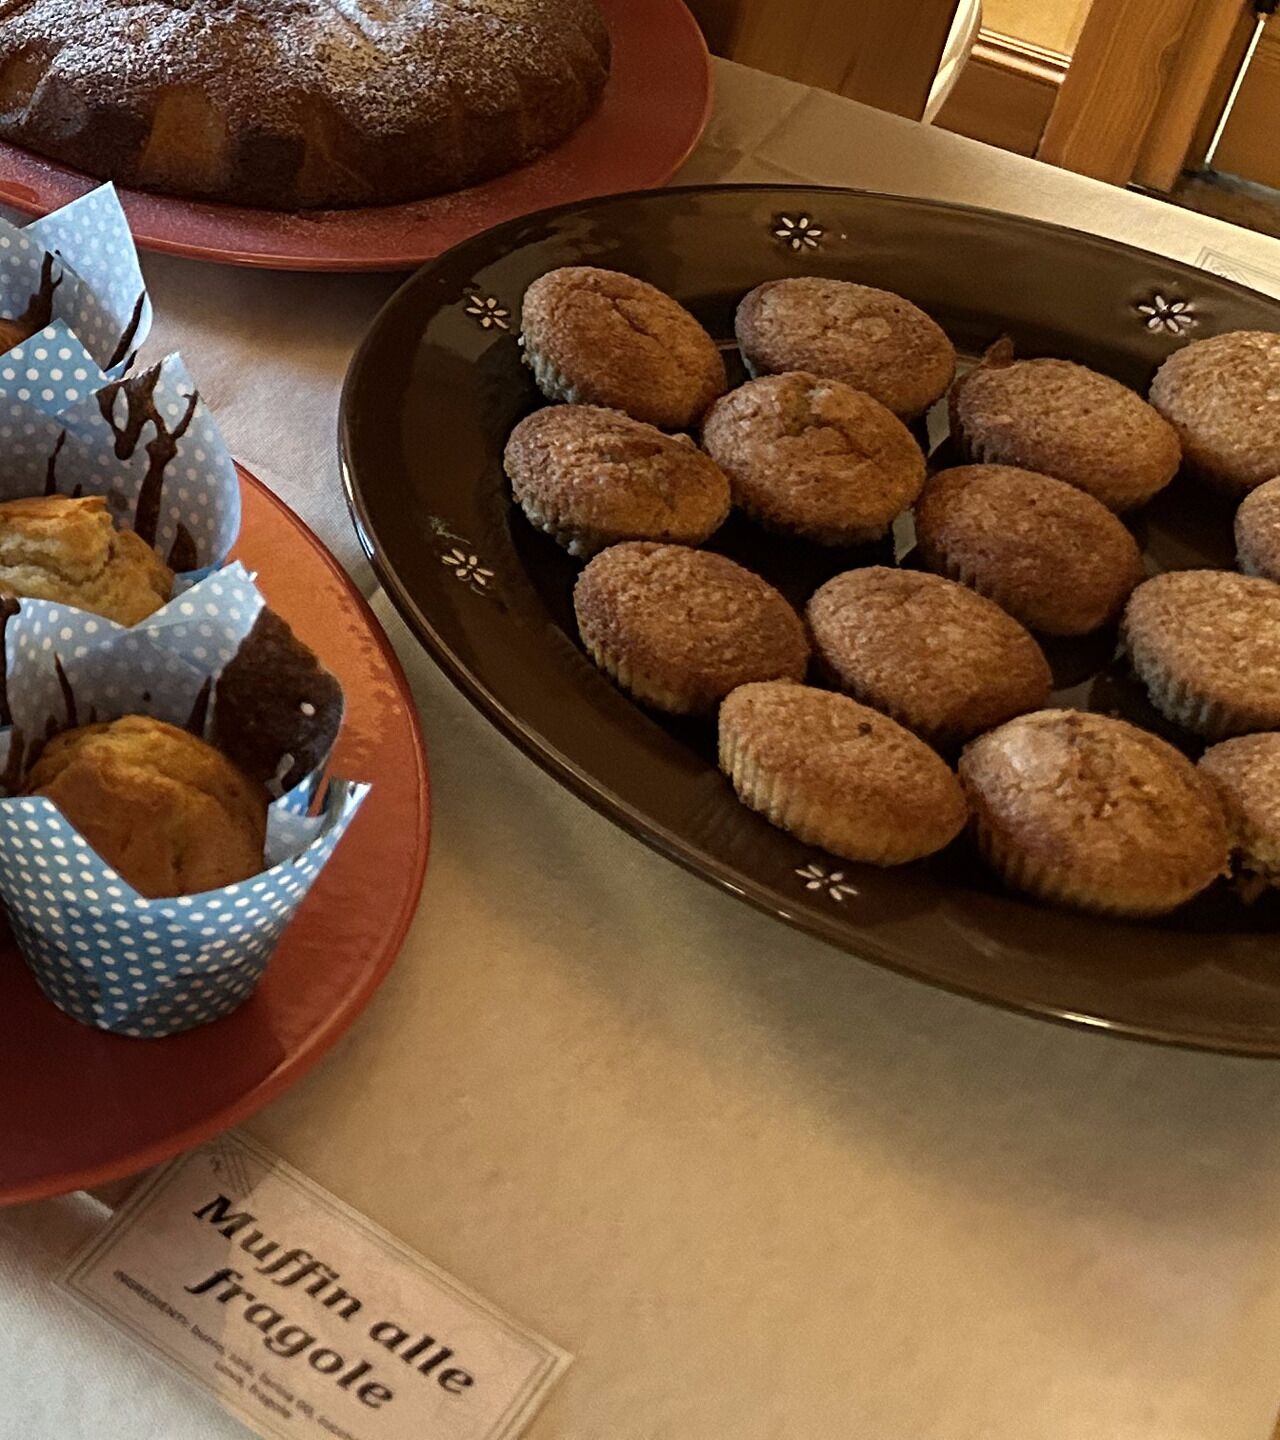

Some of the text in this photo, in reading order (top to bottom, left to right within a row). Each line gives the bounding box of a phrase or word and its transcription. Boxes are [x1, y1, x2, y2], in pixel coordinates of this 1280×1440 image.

[183, 1266, 395, 1410] fragole
[192, 1193, 476, 1396] Muffin alle
